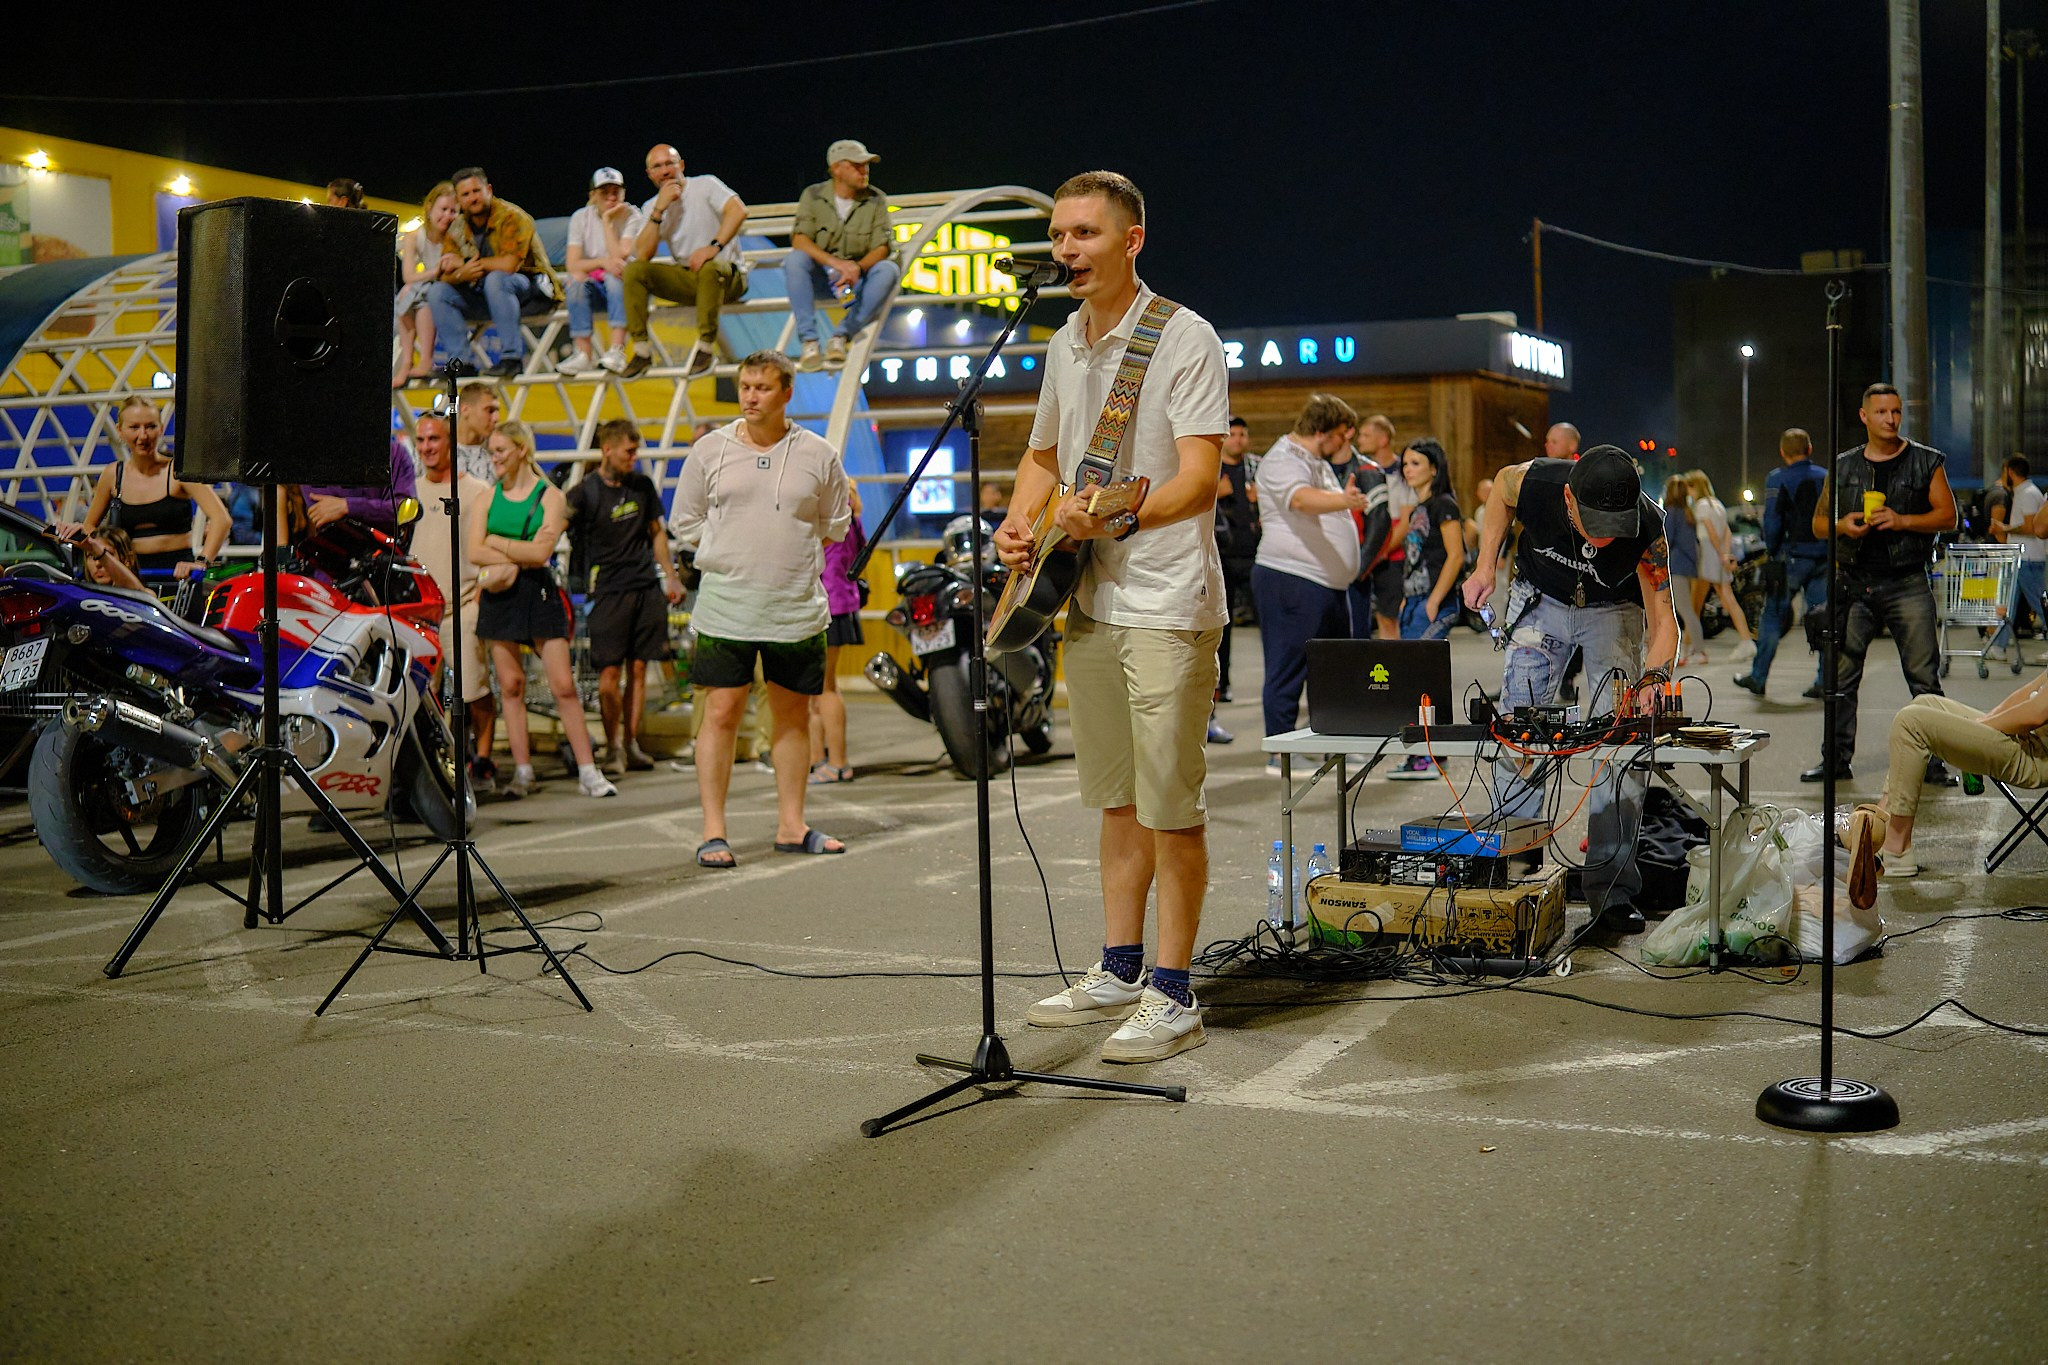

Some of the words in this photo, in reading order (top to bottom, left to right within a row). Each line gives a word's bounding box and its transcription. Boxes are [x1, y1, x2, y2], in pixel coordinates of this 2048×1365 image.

[861, 355, 1006, 384] ТИКА
[1601, 482, 1628, 507] 13
[1533, 547, 1610, 588] METALLICA
[80, 599, 142, 623] 600
[10, 642, 42, 662] 8687
[22, 664, 38, 680] 23
[317, 771, 381, 797] CBR
[1406, 834, 1427, 842] WIRELESS
[1320, 898, 1367, 909] SAMSON
